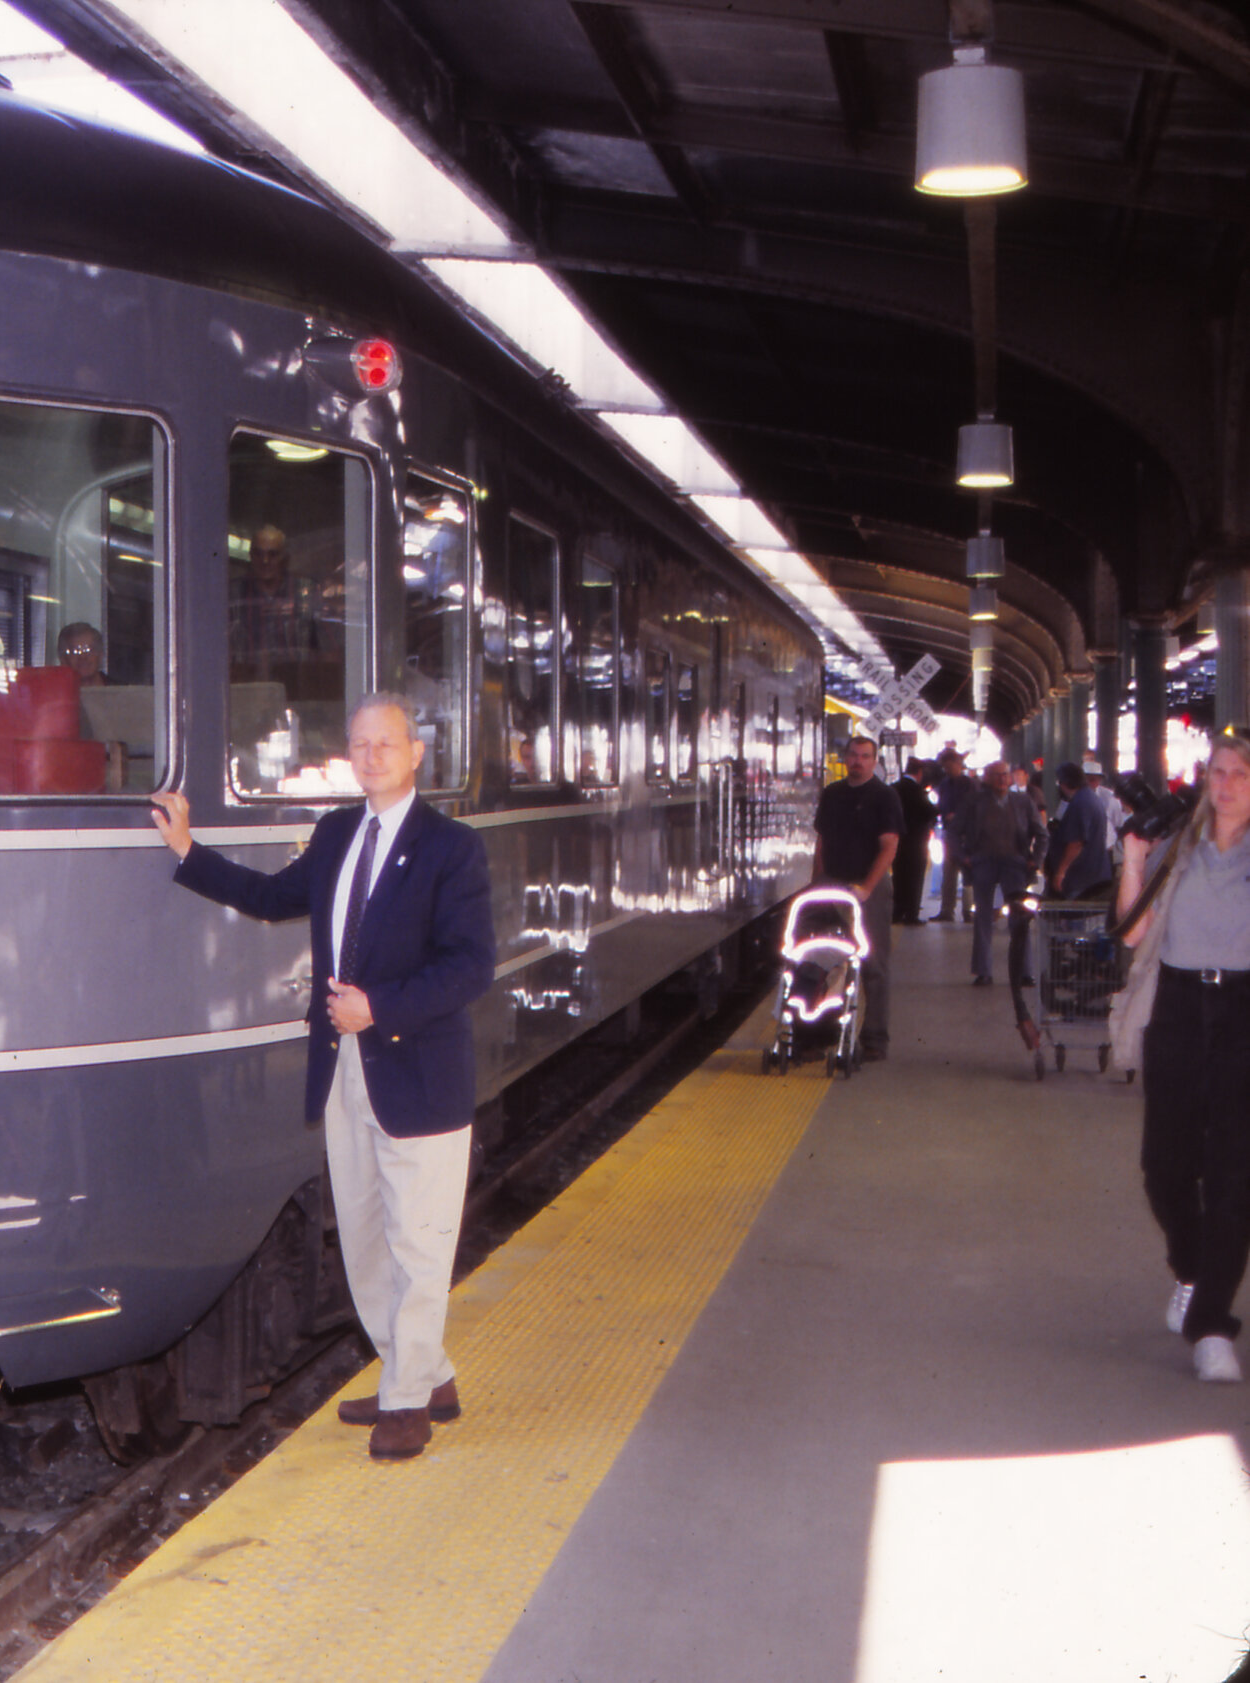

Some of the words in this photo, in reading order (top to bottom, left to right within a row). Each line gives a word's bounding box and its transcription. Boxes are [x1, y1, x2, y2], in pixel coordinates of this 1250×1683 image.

[862, 662, 889, 691] RAIL
[905, 702, 937, 733] ROAD
[865, 661, 934, 732] CROSSING
